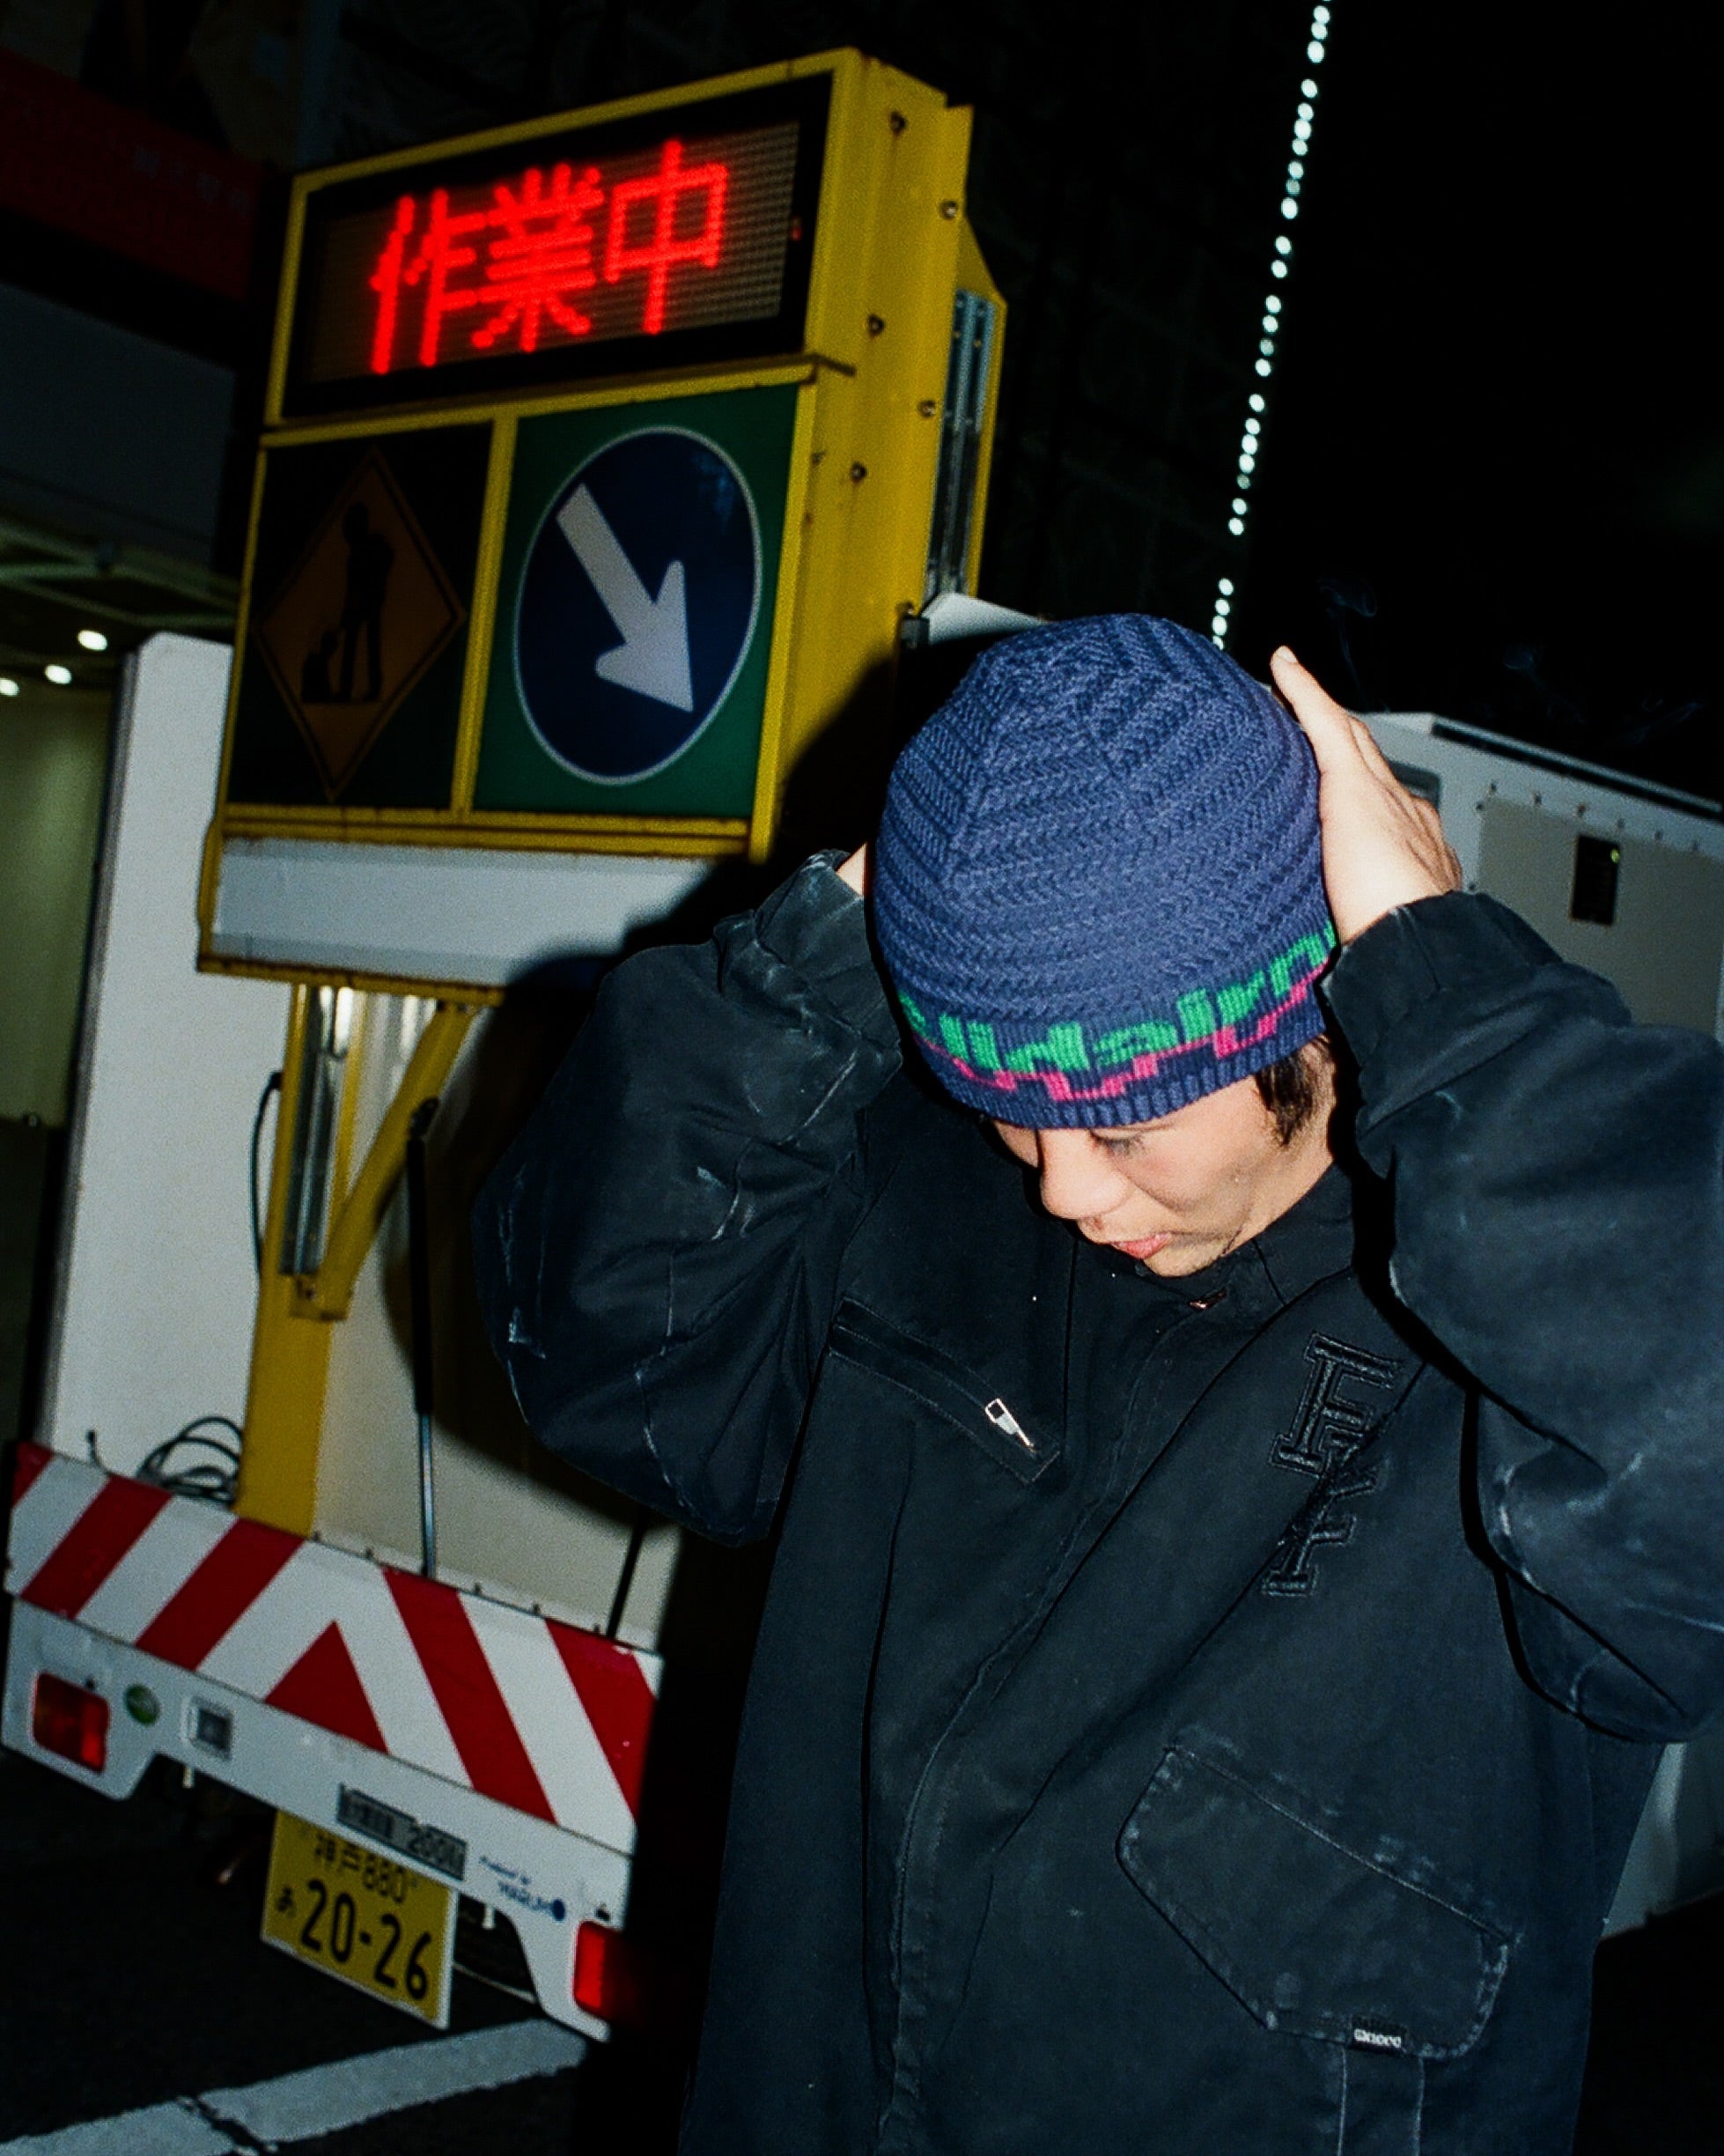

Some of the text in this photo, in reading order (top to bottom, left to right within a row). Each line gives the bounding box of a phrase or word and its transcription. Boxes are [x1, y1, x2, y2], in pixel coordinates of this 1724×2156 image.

[370, 138, 729, 375] 作業中
[301, 1879, 434, 2000] 20-26
